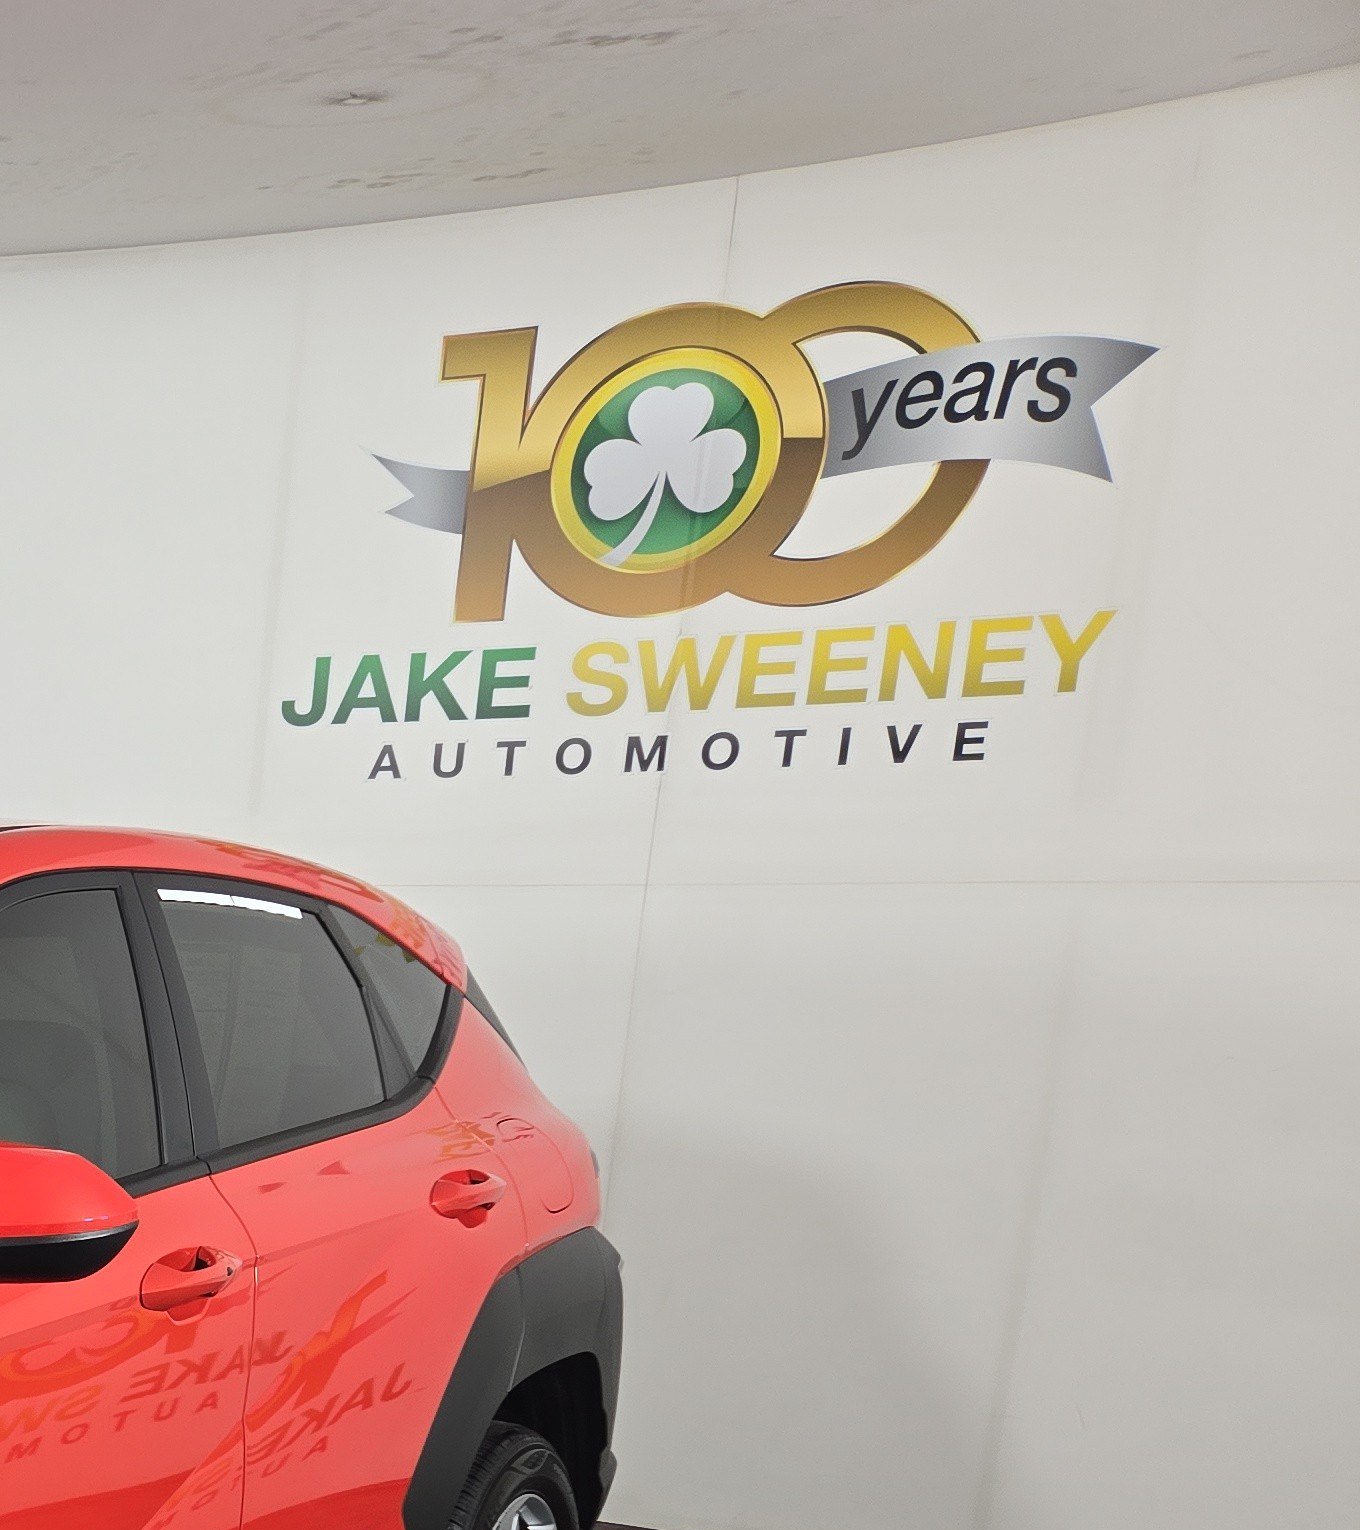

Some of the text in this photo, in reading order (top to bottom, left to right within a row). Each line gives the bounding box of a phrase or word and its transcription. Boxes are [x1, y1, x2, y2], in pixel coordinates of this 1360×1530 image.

[441, 280, 990, 622] 100
[842, 352, 1079, 460] years
[280, 610, 1118, 728] JAKE SWEENEY
[368, 720, 990, 780] AUTOMOTIVE
